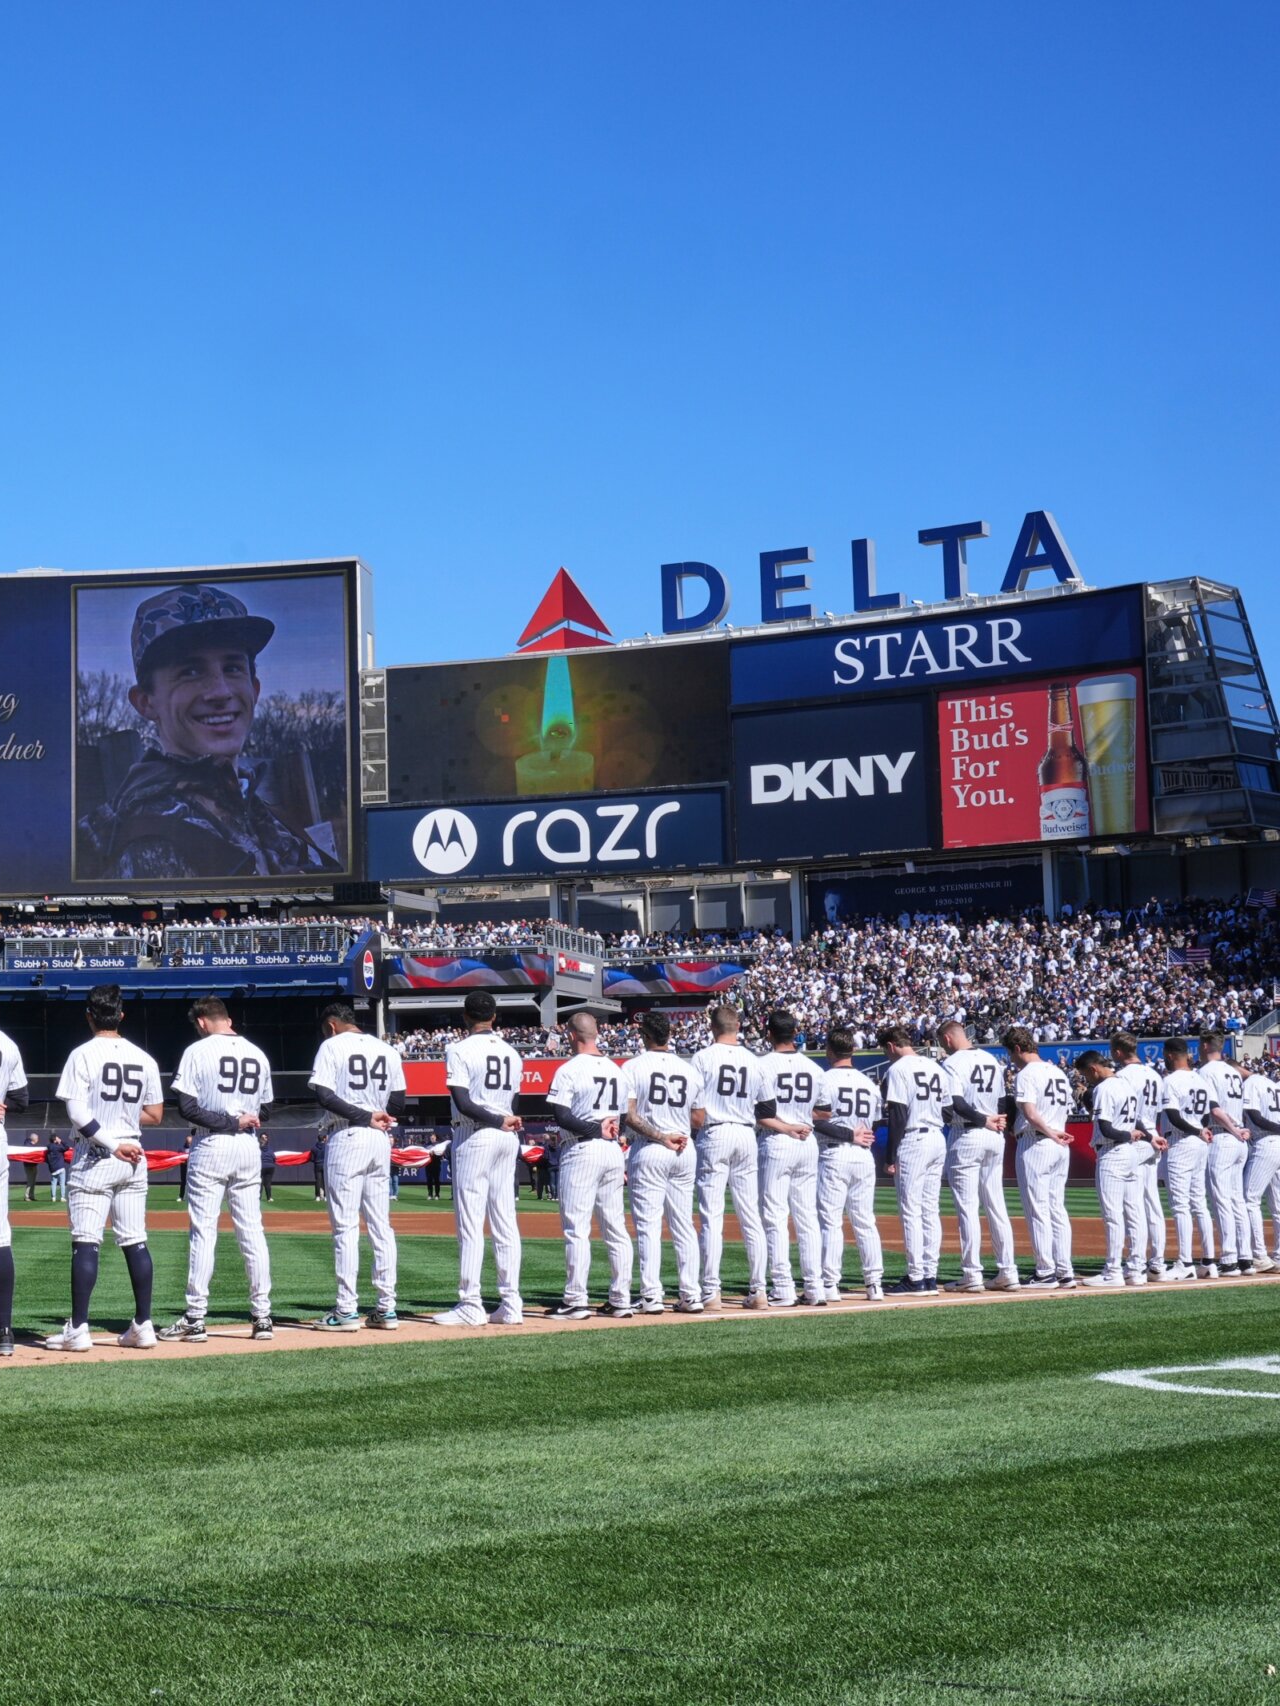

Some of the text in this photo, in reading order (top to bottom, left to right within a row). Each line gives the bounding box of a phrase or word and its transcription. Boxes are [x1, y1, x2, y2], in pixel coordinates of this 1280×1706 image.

[661, 510, 1082, 634] DELTA
[833, 617, 1032, 685] STARR
[948, 696, 1014, 724] This
[950, 722, 1029, 752] Bud's
[750, 751, 916, 804] DKNY
[951, 756, 1000, 781] For
[951, 783, 1015, 809] You.
[502, 801, 680, 867] razr
[1042, 821, 1088, 834] Budweiser
[894, 880, 1012, 896] GEORGE M. STEINBRENNER III
[935, 897, 973, 906] 1930-2010
[90, 958, 125, 968] StubHub
[212, 956, 248, 965] StubHub
[255, 955, 290, 964] StubHub
[100, 1061, 143, 1104] 95
[217, 1056, 261, 1095] 98
[347, 1054, 388, 1092] 94
[485, 1055, 512, 1091] 81
[717, 1064, 748, 1098] 61
[776, 1072, 813, 1104] 59
[913, 1071, 942, 1102] 54
[970, 1064, 996, 1093] 47
[593, 1076, 619, 1111] 71
[649, 1072, 688, 1108] 63
[835, 1087, 871, 1118] 56
[1044, 1078, 1067, 1106] 45
[1142, 1079, 1158, 1106] 41
[1184, 1089, 1208, 1115] 38
